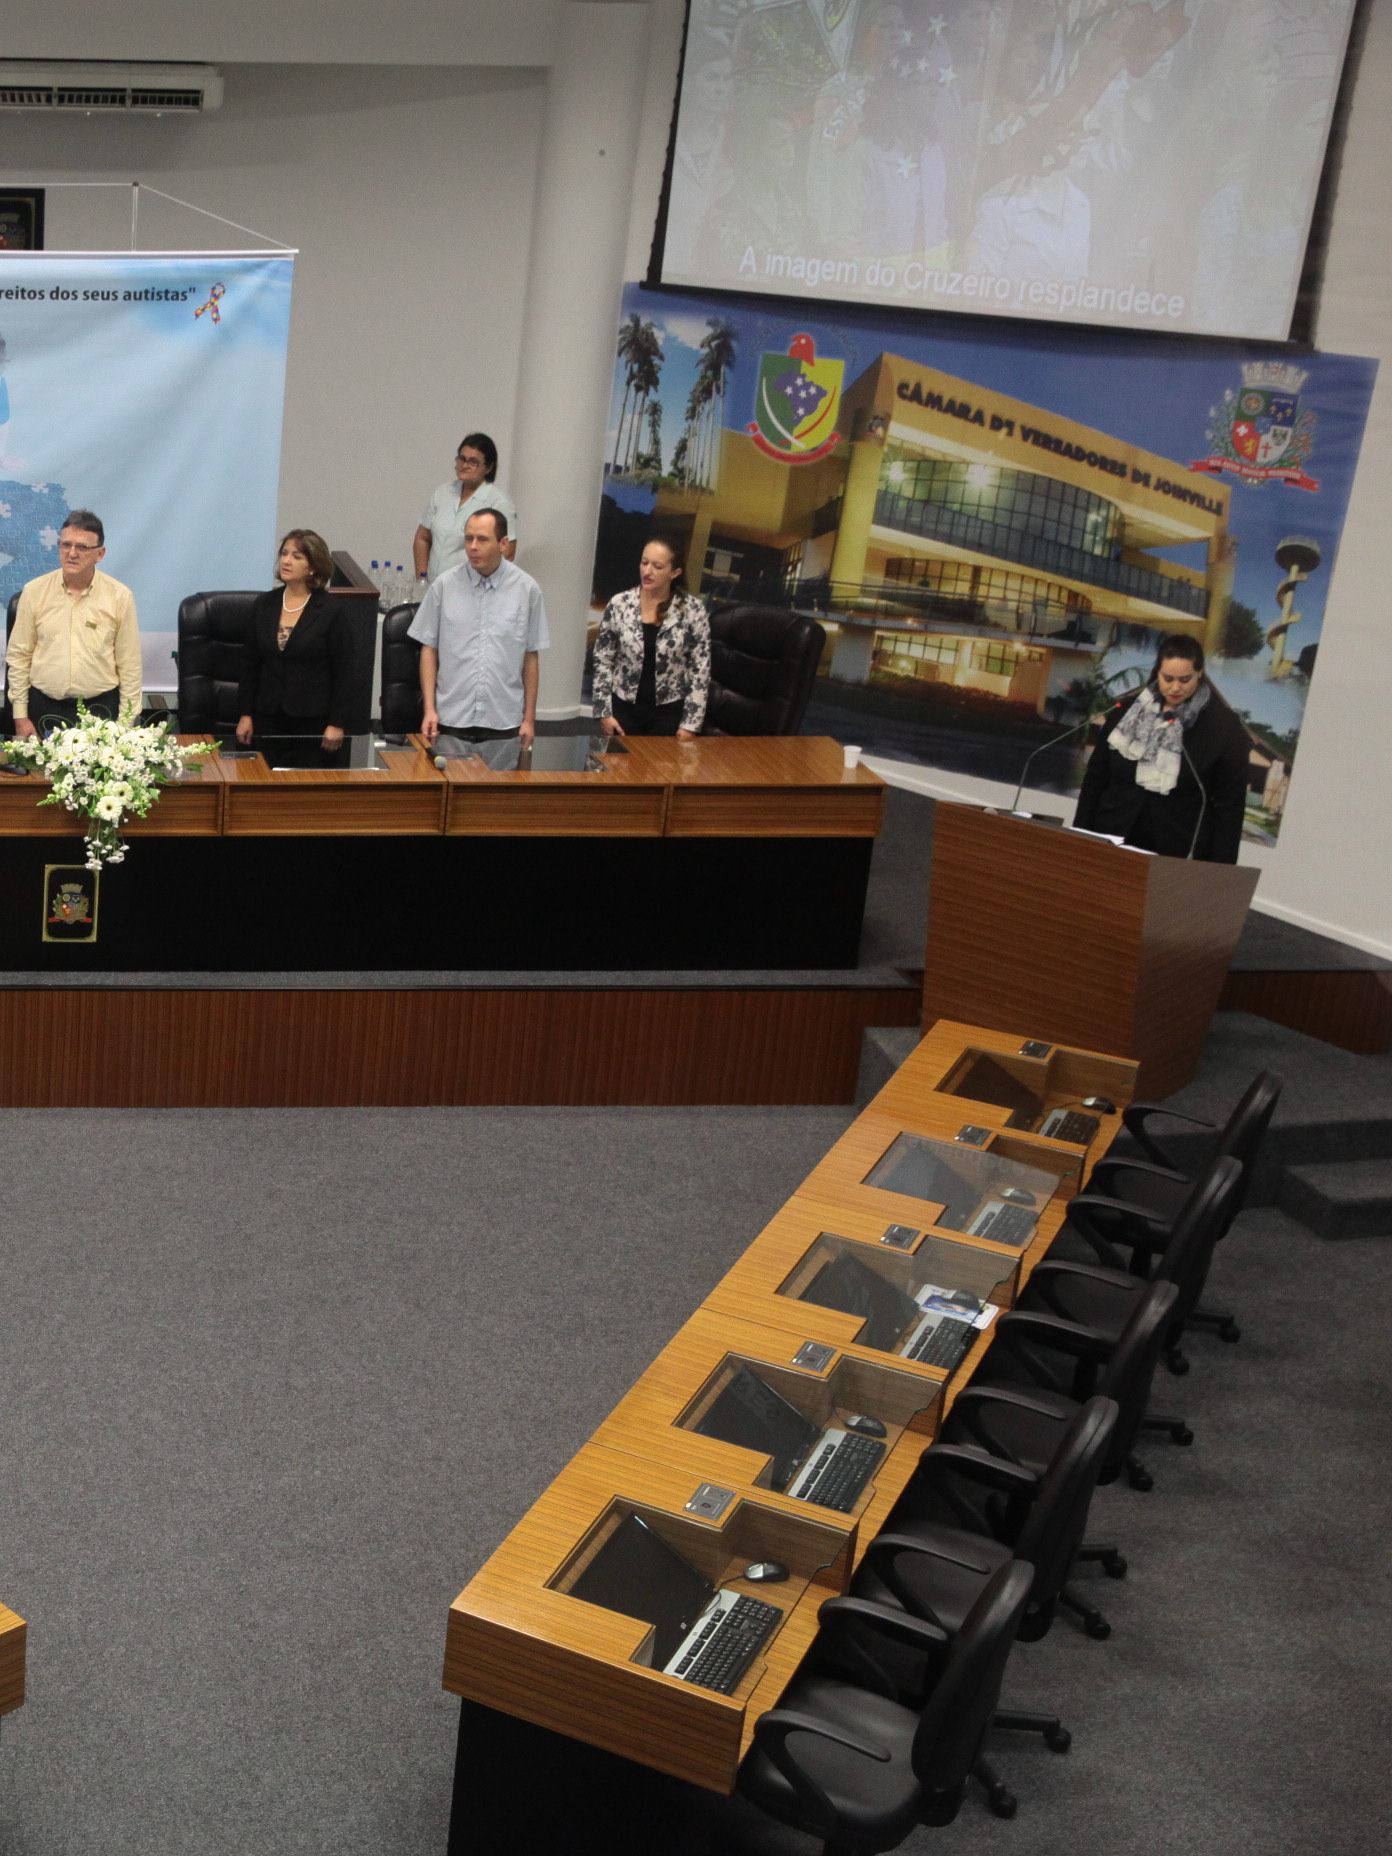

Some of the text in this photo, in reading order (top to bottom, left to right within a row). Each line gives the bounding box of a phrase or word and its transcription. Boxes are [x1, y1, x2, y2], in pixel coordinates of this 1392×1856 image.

[49, 286, 78, 301] dos
[82, 290, 119, 302] seus
[122, 286, 196, 302] autistas"
[738, 245, 1186, 318] A imagem do Cruzeiro resplandece
[896, 378, 986, 428] CÂMARA
[1019, 423, 1128, 479] VEREADORES
[1130, 467, 1152, 487] DE
[1153, 477, 1224, 517] JOINVILLE
